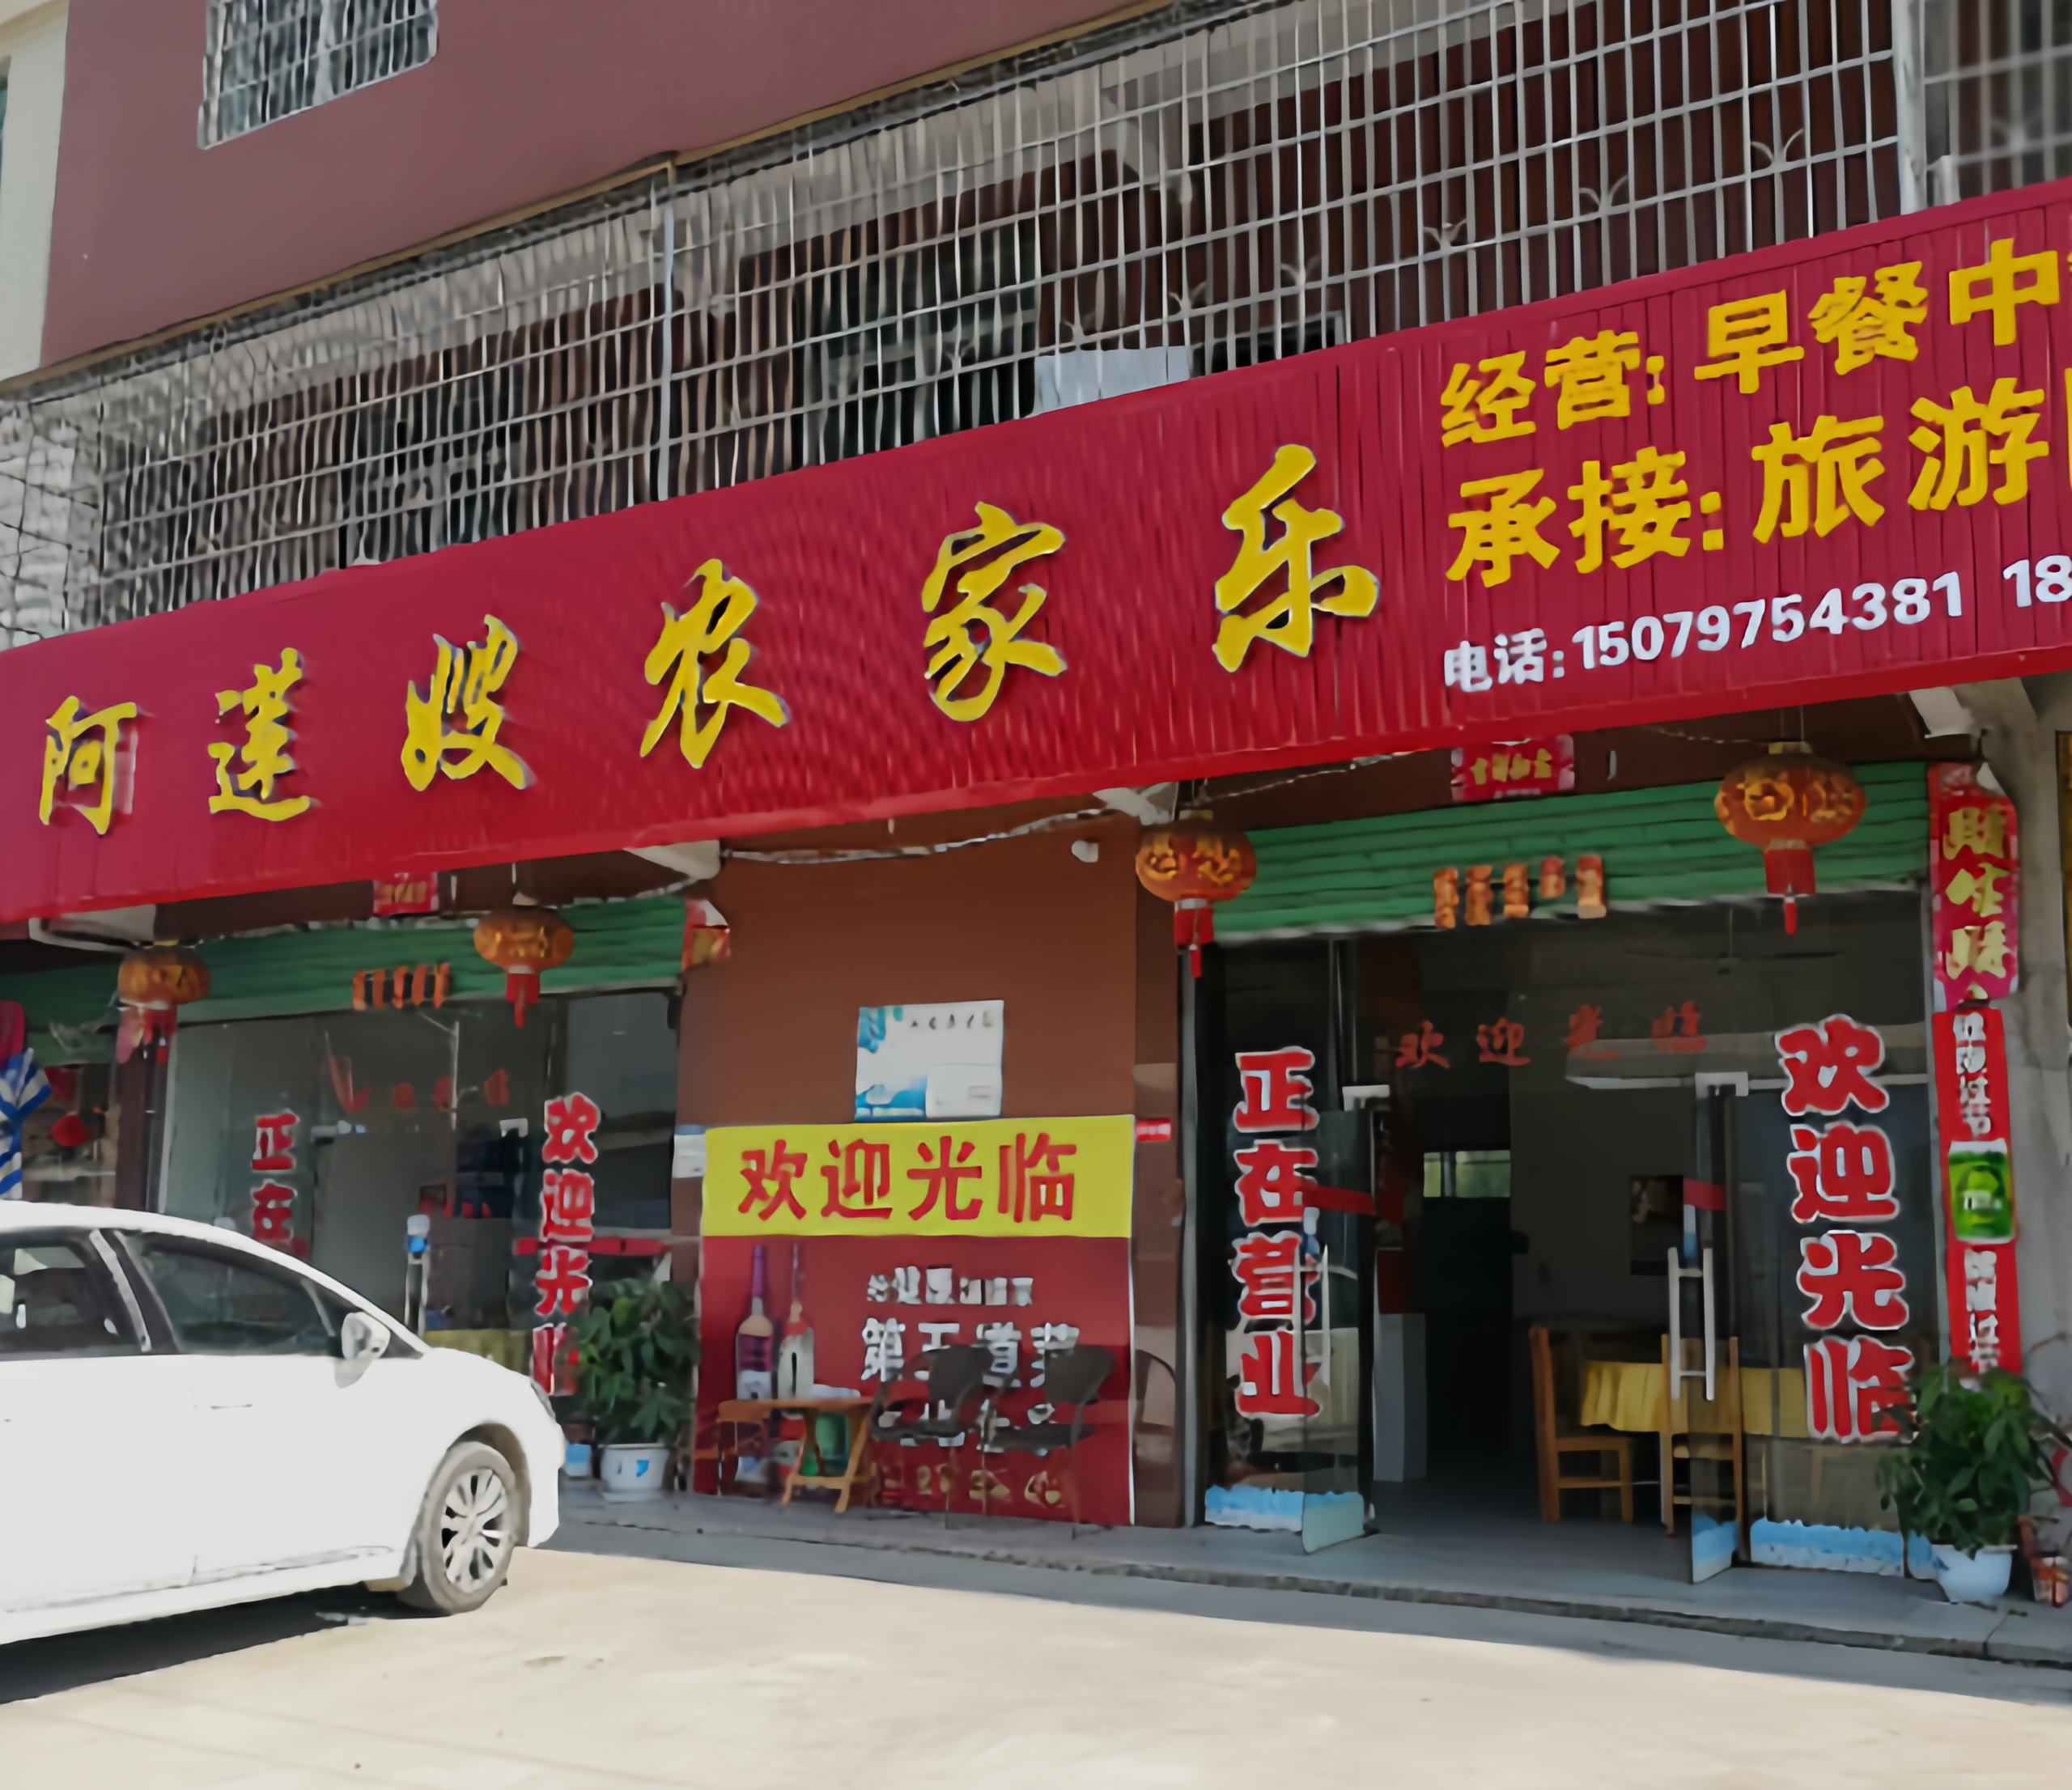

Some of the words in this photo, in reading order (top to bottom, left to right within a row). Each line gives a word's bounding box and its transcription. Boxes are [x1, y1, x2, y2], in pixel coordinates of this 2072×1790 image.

[1440, 238, 2072, 447] 经营：早餐中
[1446, 368, 2072, 587] 承接：旅游
[737, 1132, 1078, 1223] 欢迎光临
[1233, 1046, 1321, 1418] 正在营业
[1775, 1014, 1917, 1444] 欢迎光临
